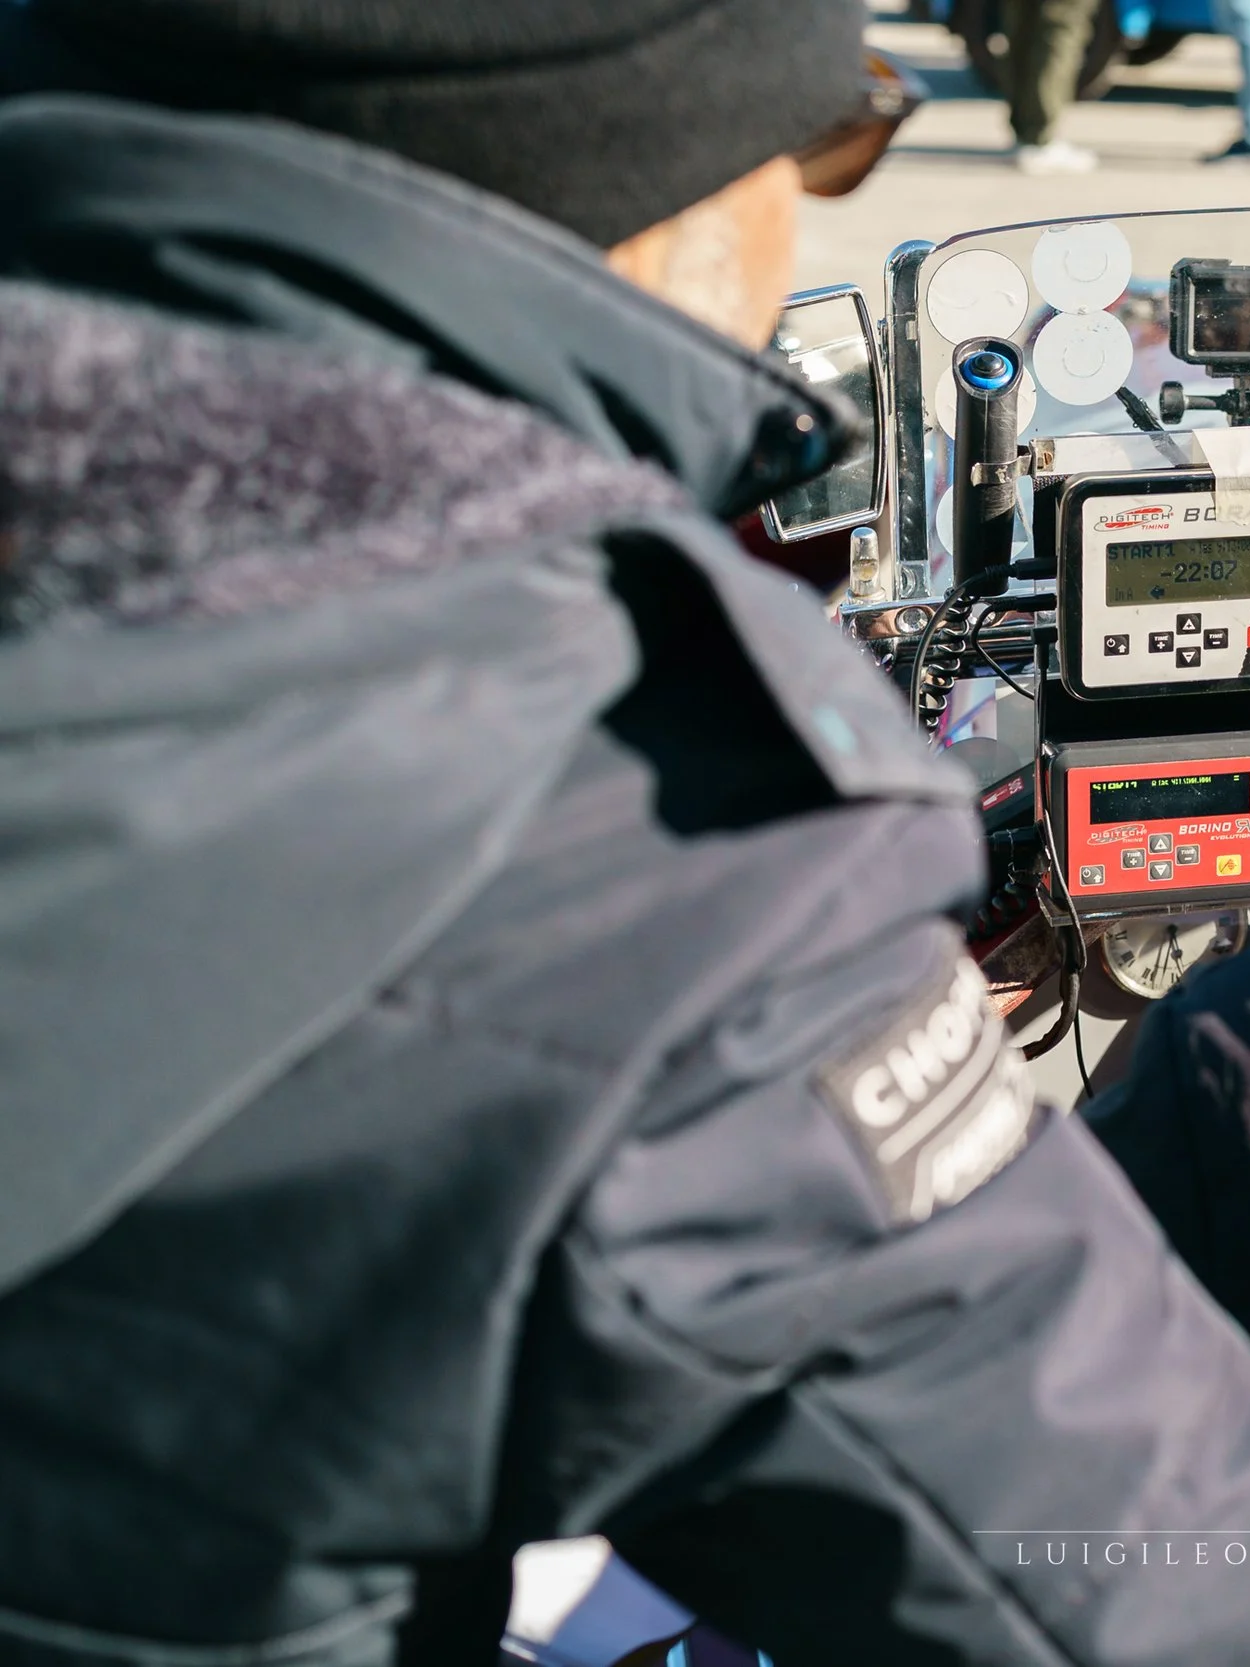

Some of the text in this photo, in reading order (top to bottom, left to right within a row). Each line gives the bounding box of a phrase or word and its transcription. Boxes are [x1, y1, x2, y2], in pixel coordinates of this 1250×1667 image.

[1099, 511, 1171, 525] DIGITECH
[1141, 523, 1170, 531] TIMING
[1091, 829, 1143, 839] DIGITECH
[1178, 821, 1232, 835] BORINO
